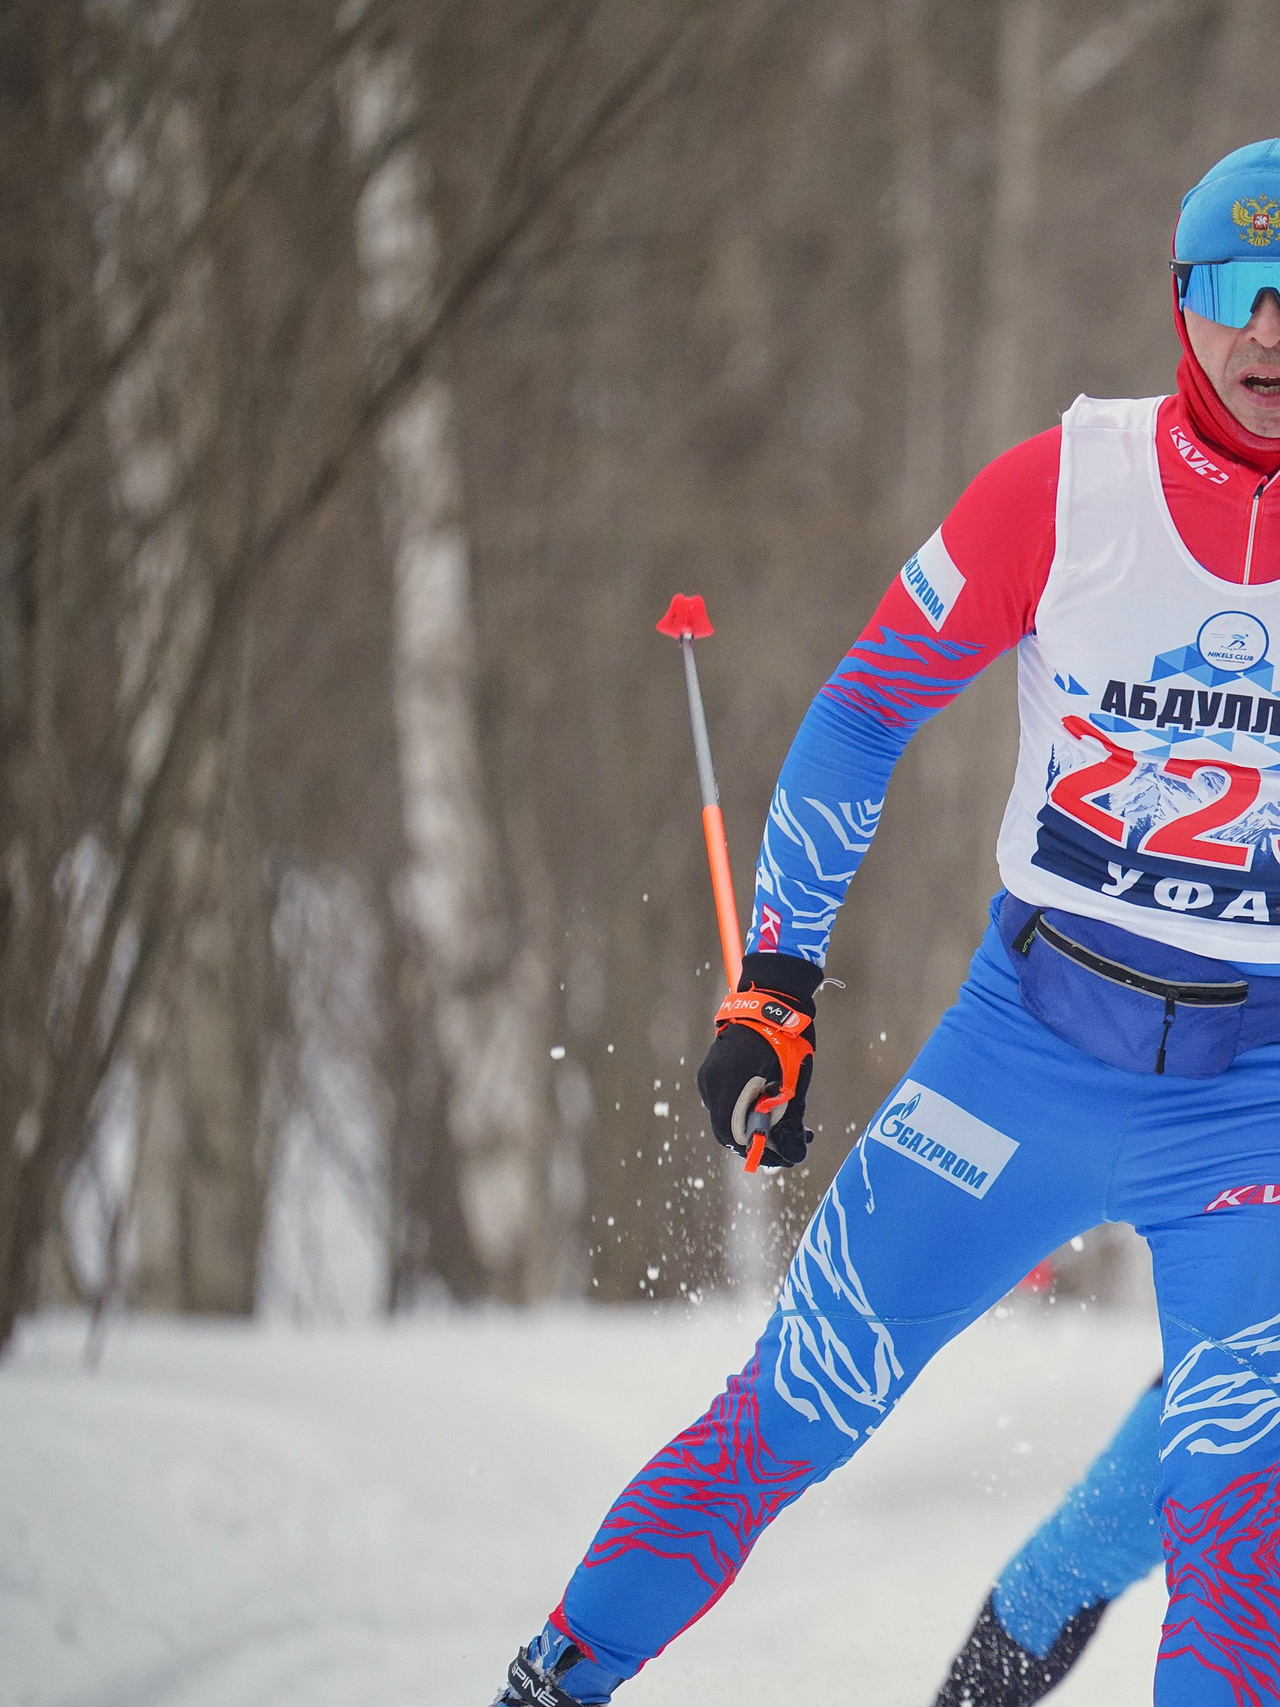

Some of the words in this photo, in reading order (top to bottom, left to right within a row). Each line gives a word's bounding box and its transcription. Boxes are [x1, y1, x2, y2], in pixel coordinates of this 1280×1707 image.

[1207, 651, 1234, 660] NIKELS
[1234, 653, 1255, 662] CLUB
[1100, 860, 1271, 923] УФА
[896, 1126, 989, 1191] GAZPROM
